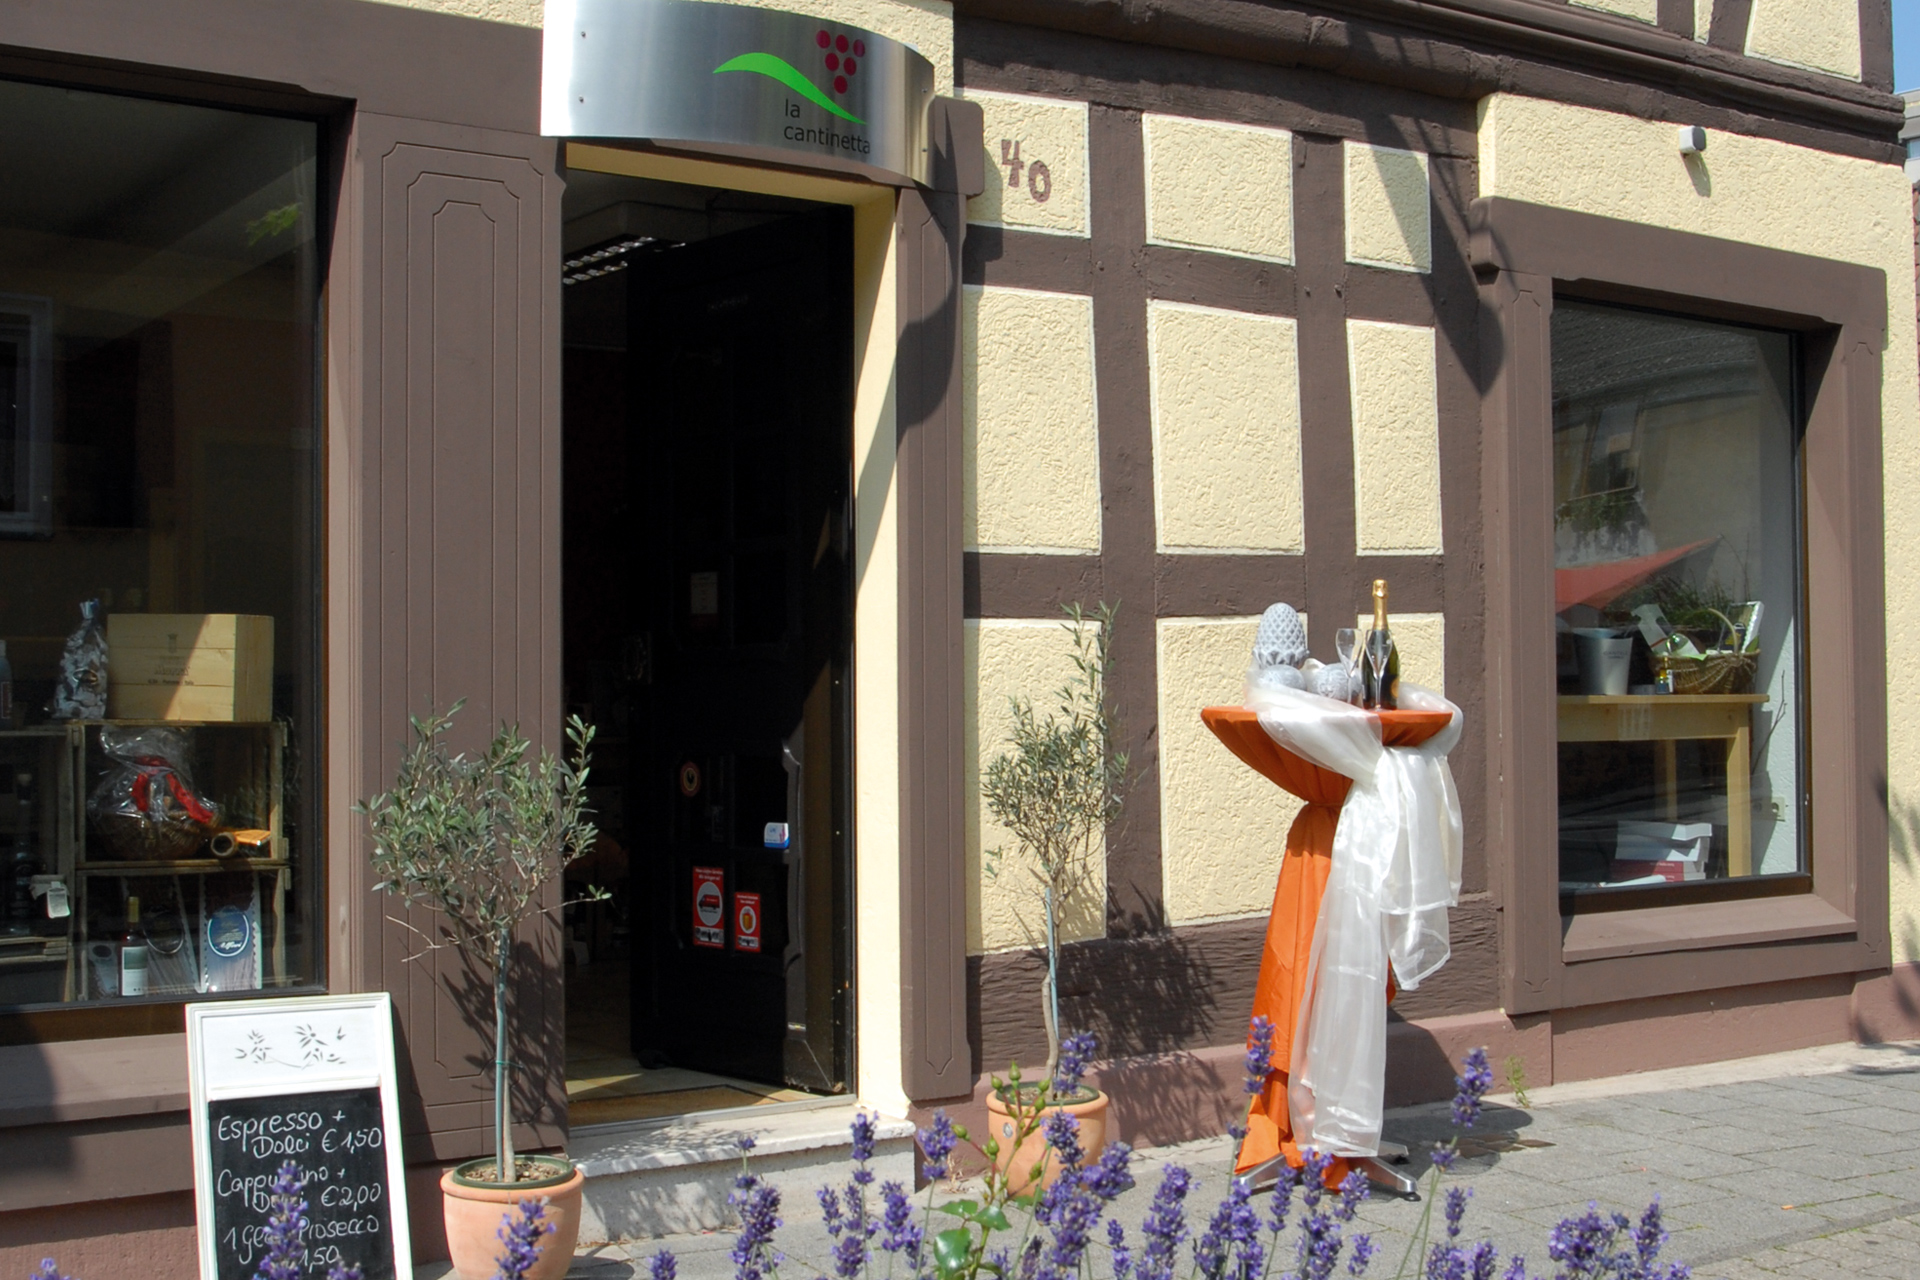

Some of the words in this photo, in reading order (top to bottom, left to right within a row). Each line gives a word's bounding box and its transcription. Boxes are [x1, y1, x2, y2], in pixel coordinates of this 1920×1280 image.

[785, 98, 800, 118] la
[783, 123, 871, 154] cantinetta
[1001, 139, 1052, 203] 40
[218, 1111, 322, 1152] Espresso
[332, 1110, 346, 1122] +
[251, 1132, 310, 1159] Dolci
[217, 1163, 329, 1207] Cappuino
[336, 1168, 346, 1179] +
[223, 1227, 237, 1252] 1
